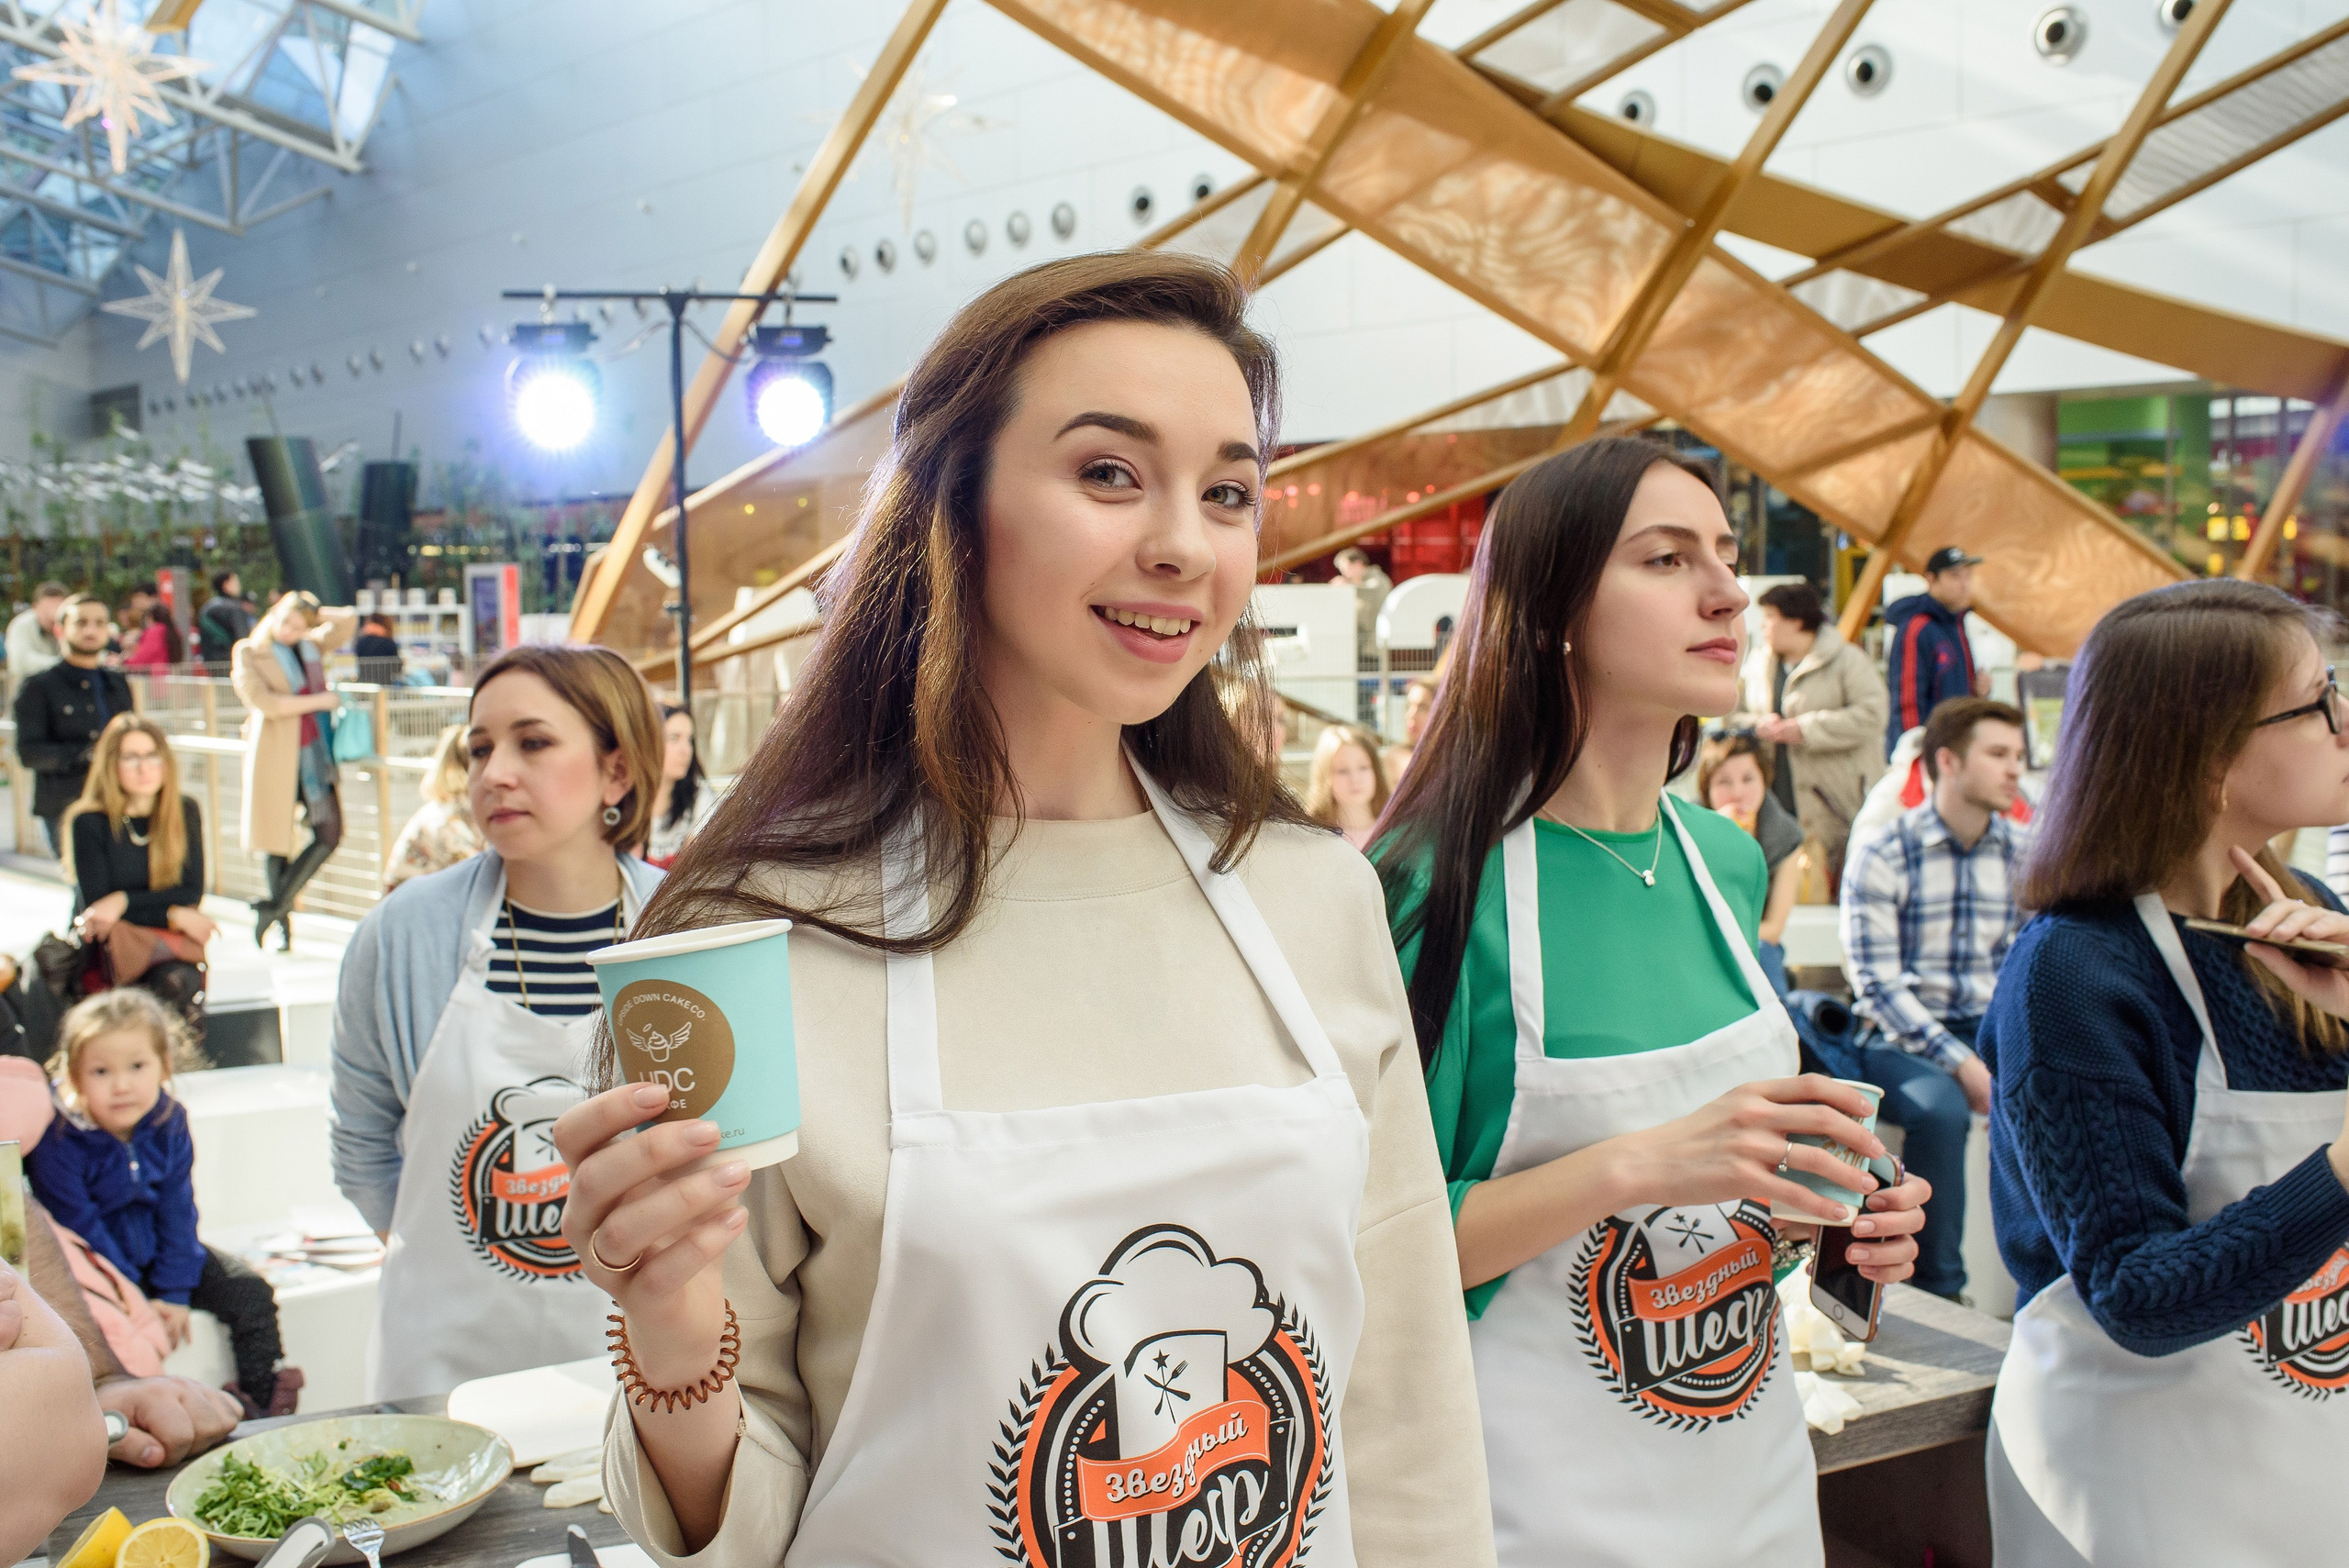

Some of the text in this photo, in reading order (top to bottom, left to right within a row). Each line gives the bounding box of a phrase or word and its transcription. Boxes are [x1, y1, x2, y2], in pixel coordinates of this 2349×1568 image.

[632, 993, 661, 1005] DOWN
[662, 993, 692, 1009] CAKE
[495, 1198, 562, 1238] Ше
[1649, 1246, 1762, 1309] Звездный
[1104, 1411, 1249, 1503] Звездный
